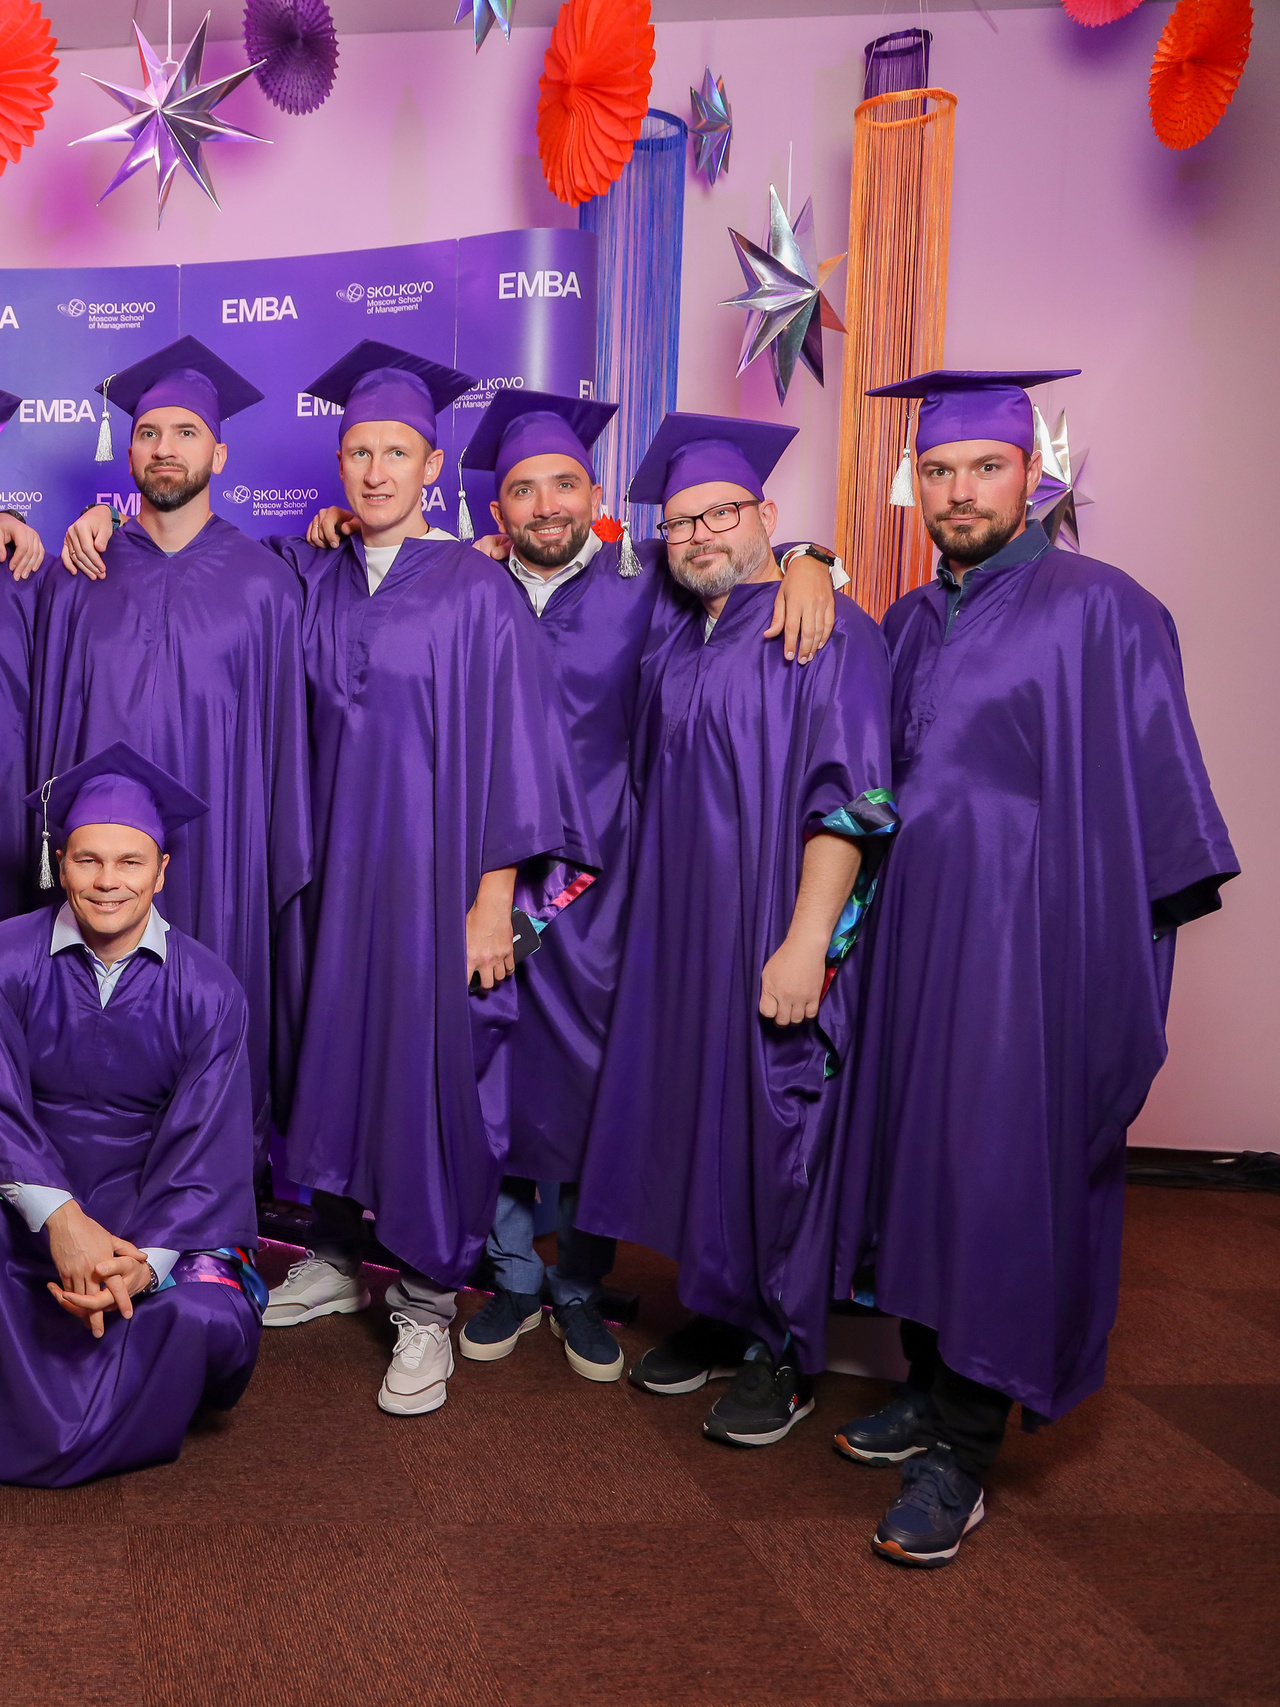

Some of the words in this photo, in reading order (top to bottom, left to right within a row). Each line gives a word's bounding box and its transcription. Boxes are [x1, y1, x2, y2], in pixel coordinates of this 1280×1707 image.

[366, 280, 434, 299] SKOLKOVO
[499, 270, 582, 299] EMBA
[367, 298, 397, 307] Moscow
[398, 295, 423, 304] School
[88, 301, 156, 315] SKOLKOVO
[222, 295, 298, 324] EMBA
[375, 303, 419, 314] Management
[120, 314, 145, 322] School
[88, 321, 96, 329] of
[97, 321, 141, 330] Management
[468, 376, 524, 392] OLKOVO
[20, 399, 96, 422] EMBA
[454, 401, 462, 409] of
[462, 400, 492, 409] Manage
[252, 488, 319, 501] SKOLKOVO
[252, 501, 282, 509] Moscow
[283, 501, 308, 509] School
[252, 508, 260, 516] of
[261, 508, 304, 518] Management
